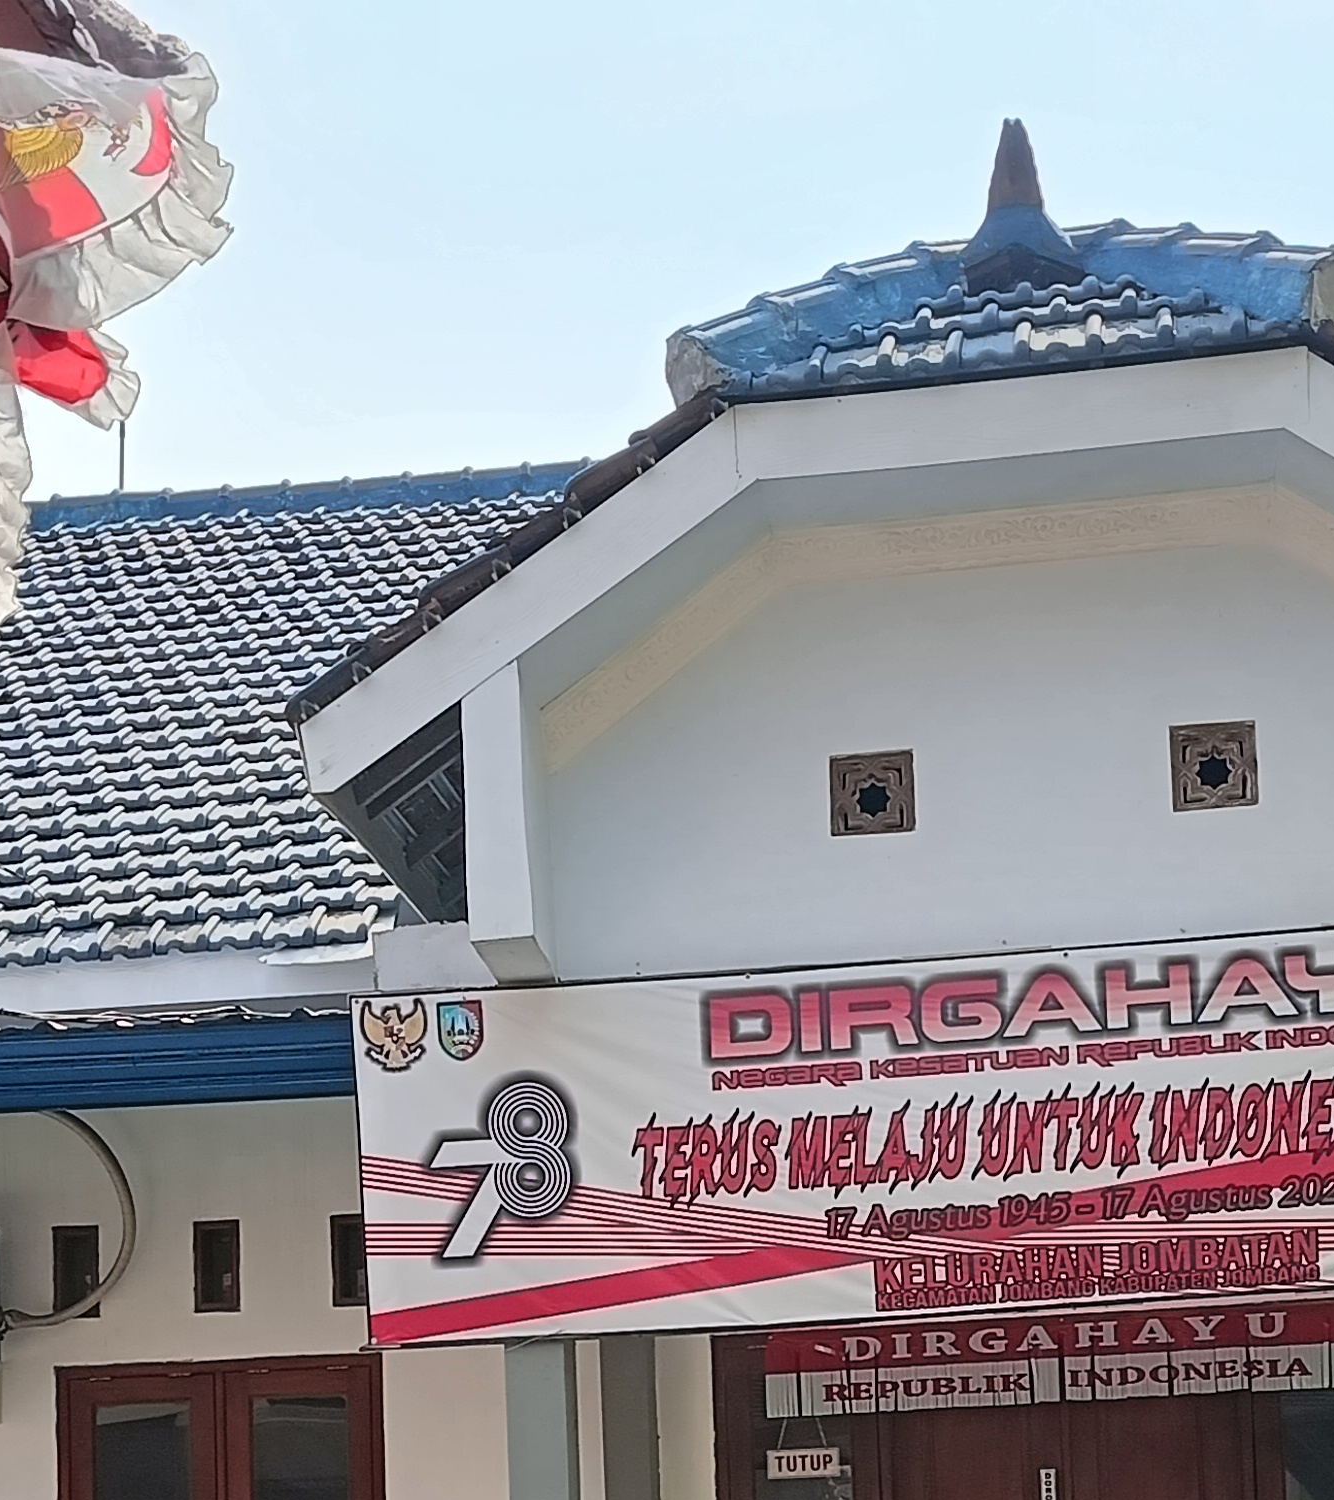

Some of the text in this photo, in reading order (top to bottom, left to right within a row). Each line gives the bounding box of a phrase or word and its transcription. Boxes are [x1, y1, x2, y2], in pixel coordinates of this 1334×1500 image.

[429, 1080, 573, 1259] 78
[631, 1108, 781, 1208] TERUS
[785, 1092, 973, 1198] MELAJU
[971, 1080, 1146, 1182] UNTUK
[825, 1205, 856, 1239] 17
[862, 1199, 991, 1241] Agustus
[998, 1192, 1073, 1228] 1945
[1101, 1189, 1133, 1220] 17
[1140, 1180, 1272, 1222] Agustus
[874, 1228, 1319, 1294] KELURAHAN JOMBATAN
[876, 1262, 1320, 1312] KECAMATAN JOMBANG KABUPATEN JOMBANG
[841, 1311, 1288, 1362] DIRGAHAYU
[822, 1357, 1313, 1402] REPUBLIK INDONESIA
[774, 1453, 834, 1473] TUTUP
